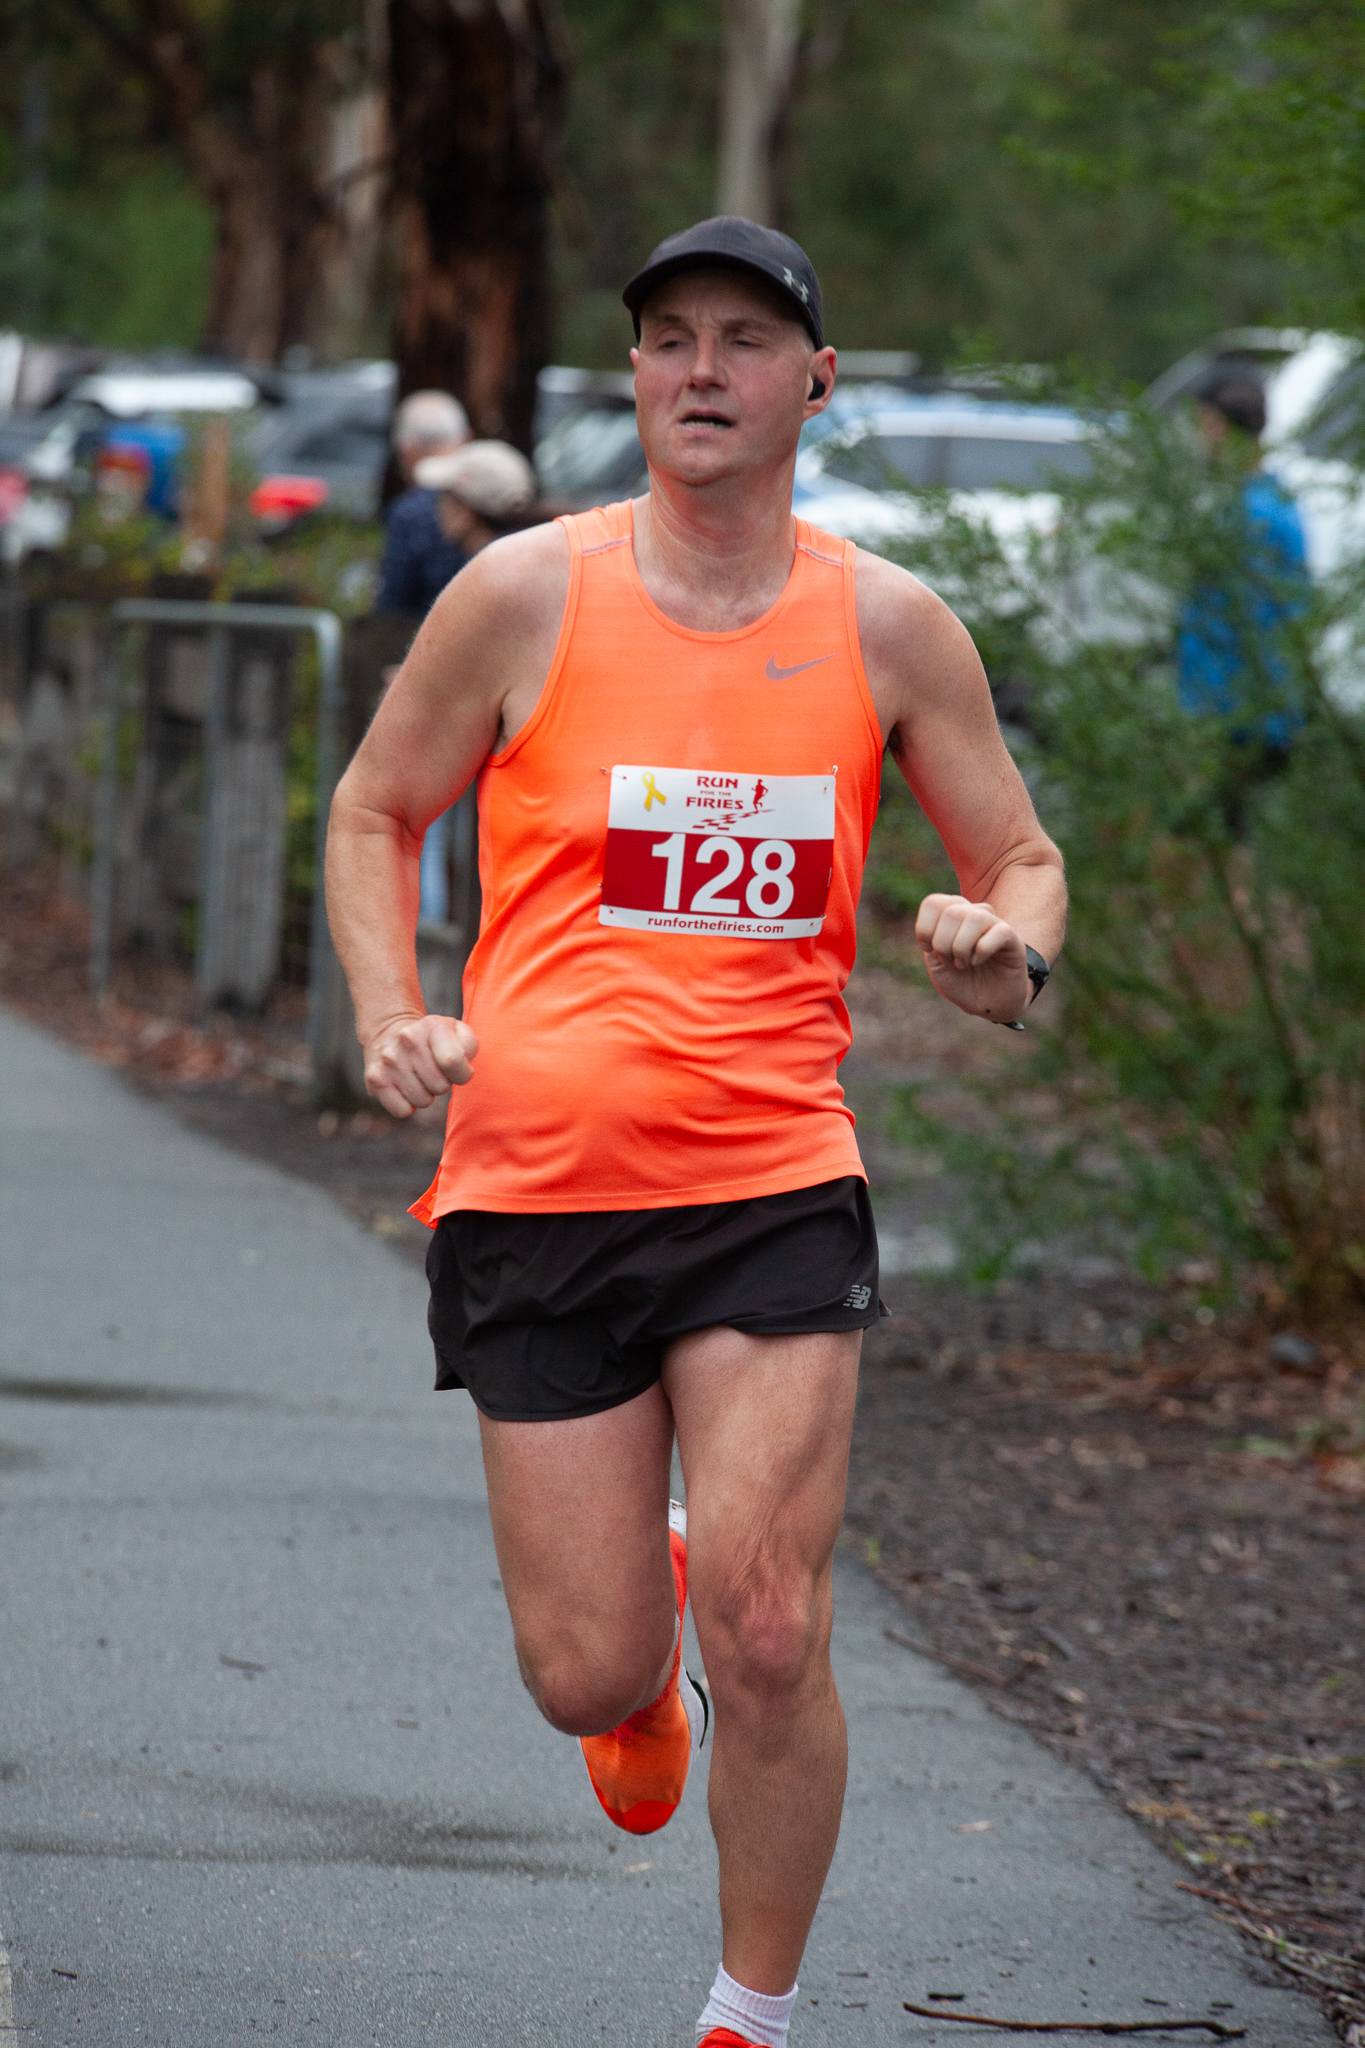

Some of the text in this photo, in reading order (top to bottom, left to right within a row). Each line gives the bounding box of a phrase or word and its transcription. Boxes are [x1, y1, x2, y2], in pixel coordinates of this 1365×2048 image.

[697, 776, 738, 789] RUN
[686, 797, 743, 810] FIRIES
[652, 833, 796, 918] 128
[648, 916, 784, 934] runforthefiries.com
